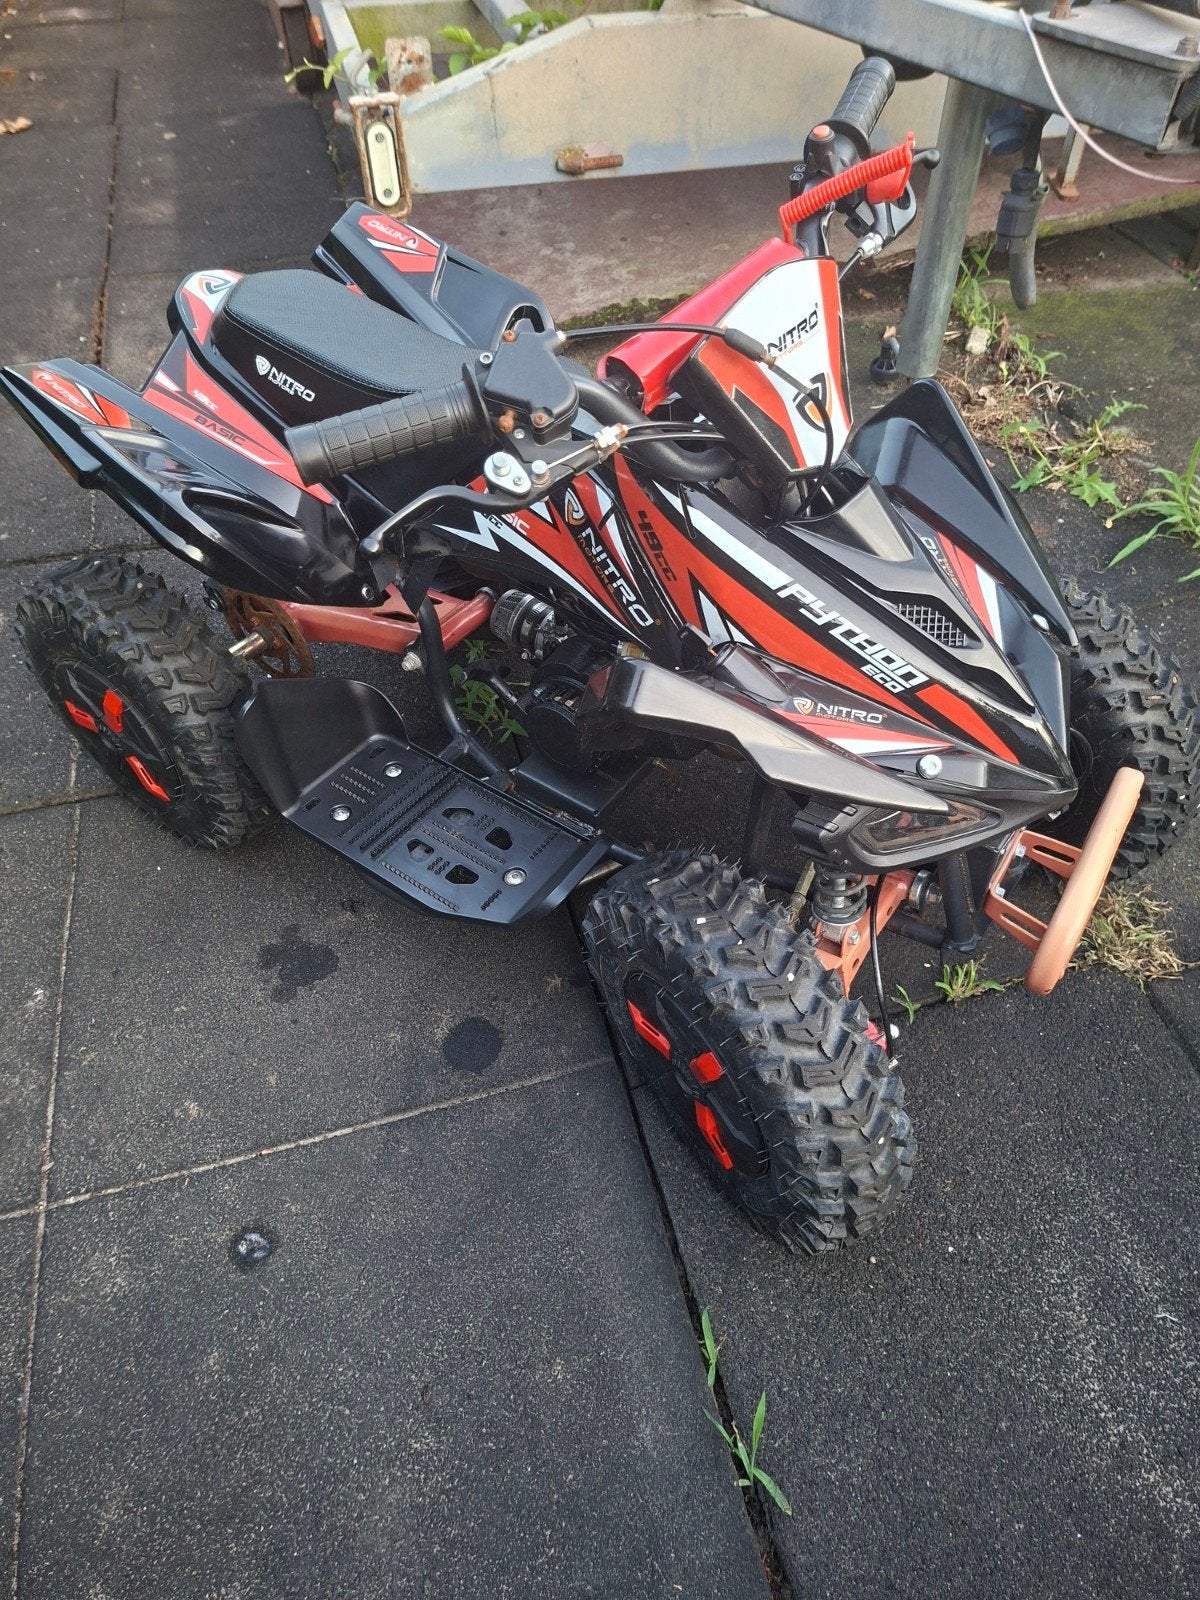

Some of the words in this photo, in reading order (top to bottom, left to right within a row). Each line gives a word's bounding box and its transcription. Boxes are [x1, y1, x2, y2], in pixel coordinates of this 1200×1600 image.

[767, 309, 819, 355] NITRO
[268, 366, 316, 402] NITRO
[194, 414, 246, 446] BASIC
[500, 513, 530, 536] SIC
[581, 527, 655, 627] NITRO
[776, 583, 930, 689] PYTHON
[860, 663, 905, 694] ECO
[816, 702, 883, 724] NITRO
